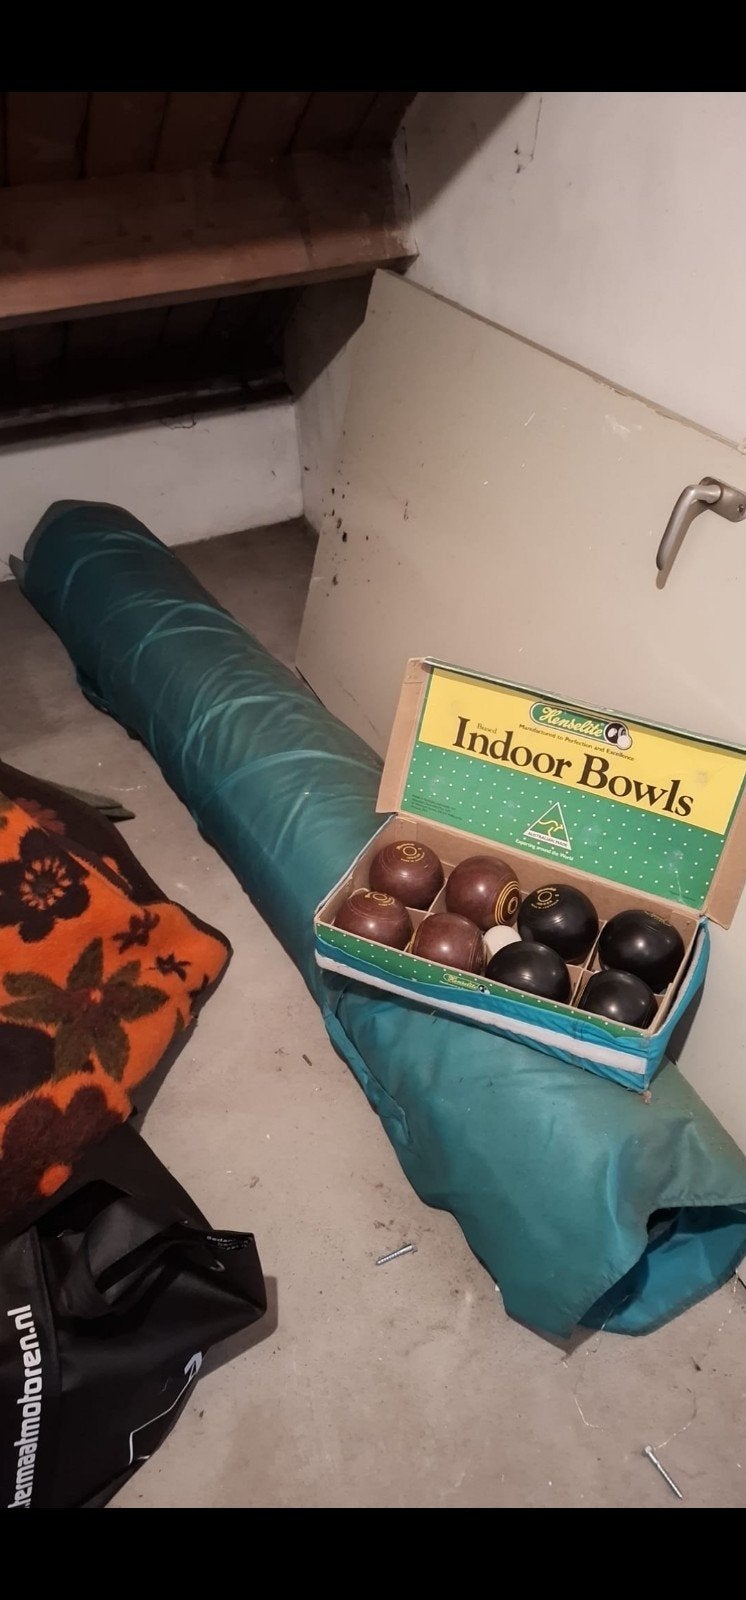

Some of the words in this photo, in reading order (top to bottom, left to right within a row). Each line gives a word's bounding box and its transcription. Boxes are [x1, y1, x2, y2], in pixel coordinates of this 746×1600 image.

[539, 706, 603, 738] Henselite
[565, 736, 593, 750] Perfection
[606, 748, 635, 762] Excellence
[452, 715, 573, 779] Indoor
[576, 753, 694, 817] Bowls
